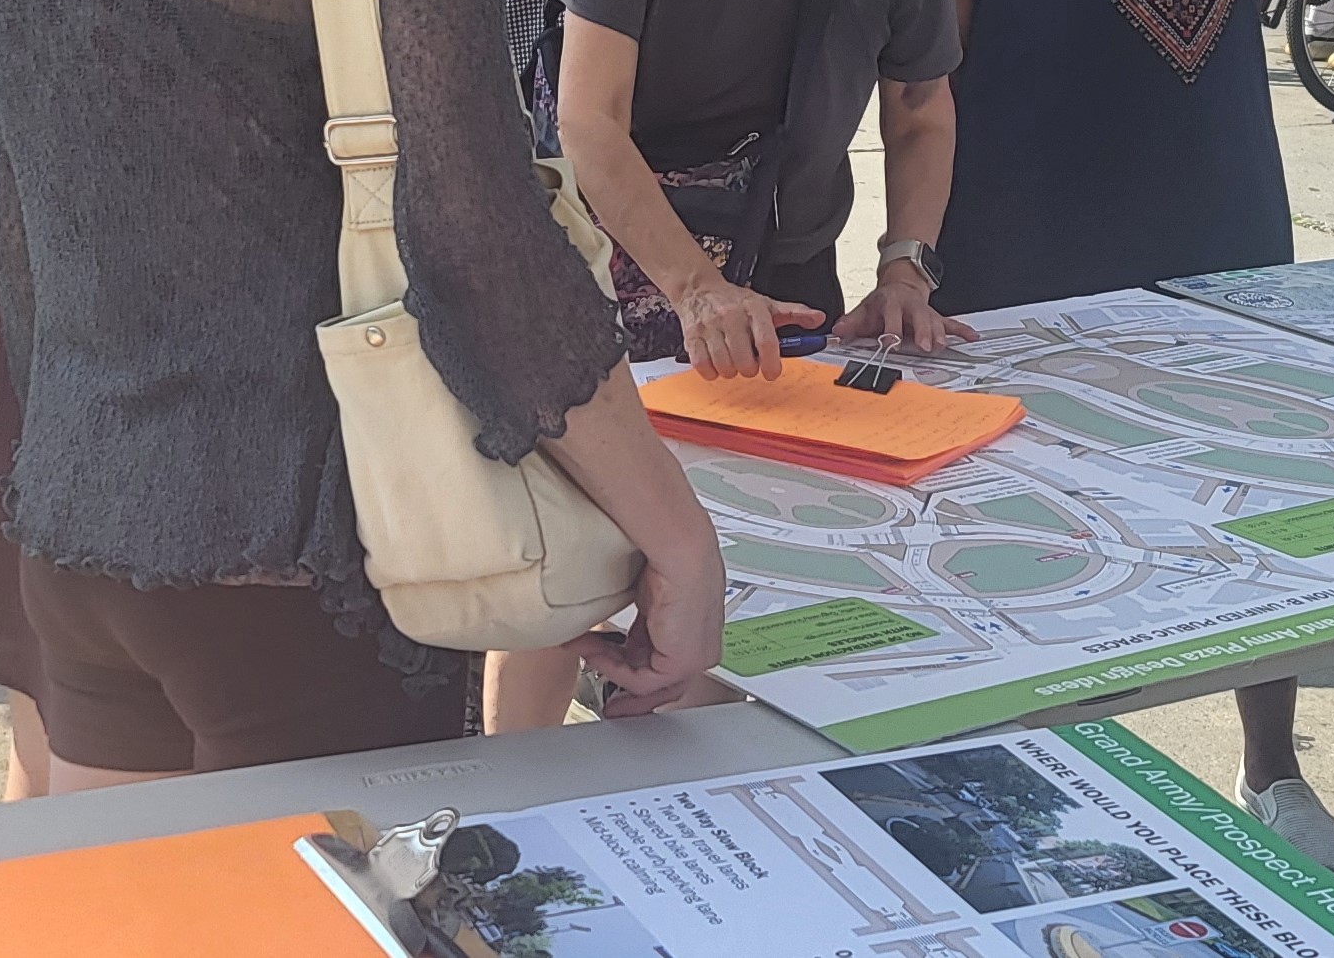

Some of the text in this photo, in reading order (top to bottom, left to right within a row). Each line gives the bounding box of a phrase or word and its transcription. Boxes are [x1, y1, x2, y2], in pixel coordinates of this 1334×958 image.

[1151, 617, 1218, 639] PUBLIC
[1215, 600, 1280, 625] UNIFIED
[766, 631, 924, 669] NO. OF INTERACTION POINTS
[826, 625, 914, 648] WITH VEHICLES
[1081, 633, 1154, 654] SPACES
[1182, 641, 1247, 661] Plaza
[1238, 626, 1301, 653] Army
[1100, 656, 1185, 680] Design
[1033, 674, 1105, 699] Ideas
[1073, 721, 1152, 778] Grand
[1135, 768, 1317, 889] Army/Prospect
[632, 807, 715, 886] Shared bike lanes
[657, 803, 750, 891] Two way travel lanes
[672, 791, 770, 880] Two Way Slow Block
[1014, 737, 1079, 780] WHERE
[1068, 777, 1133, 821] WOULD
[1123, 819, 1169, 847] YOU
[1159, 846, 1225, 886] PLACE
[1214, 885, 1283, 933] THESE
[1270, 930, 1321, 958] BLO
[582, 815, 667, 896] Mid-block calming
[607, 811, 724, 926] Flexible curb/parking lane
